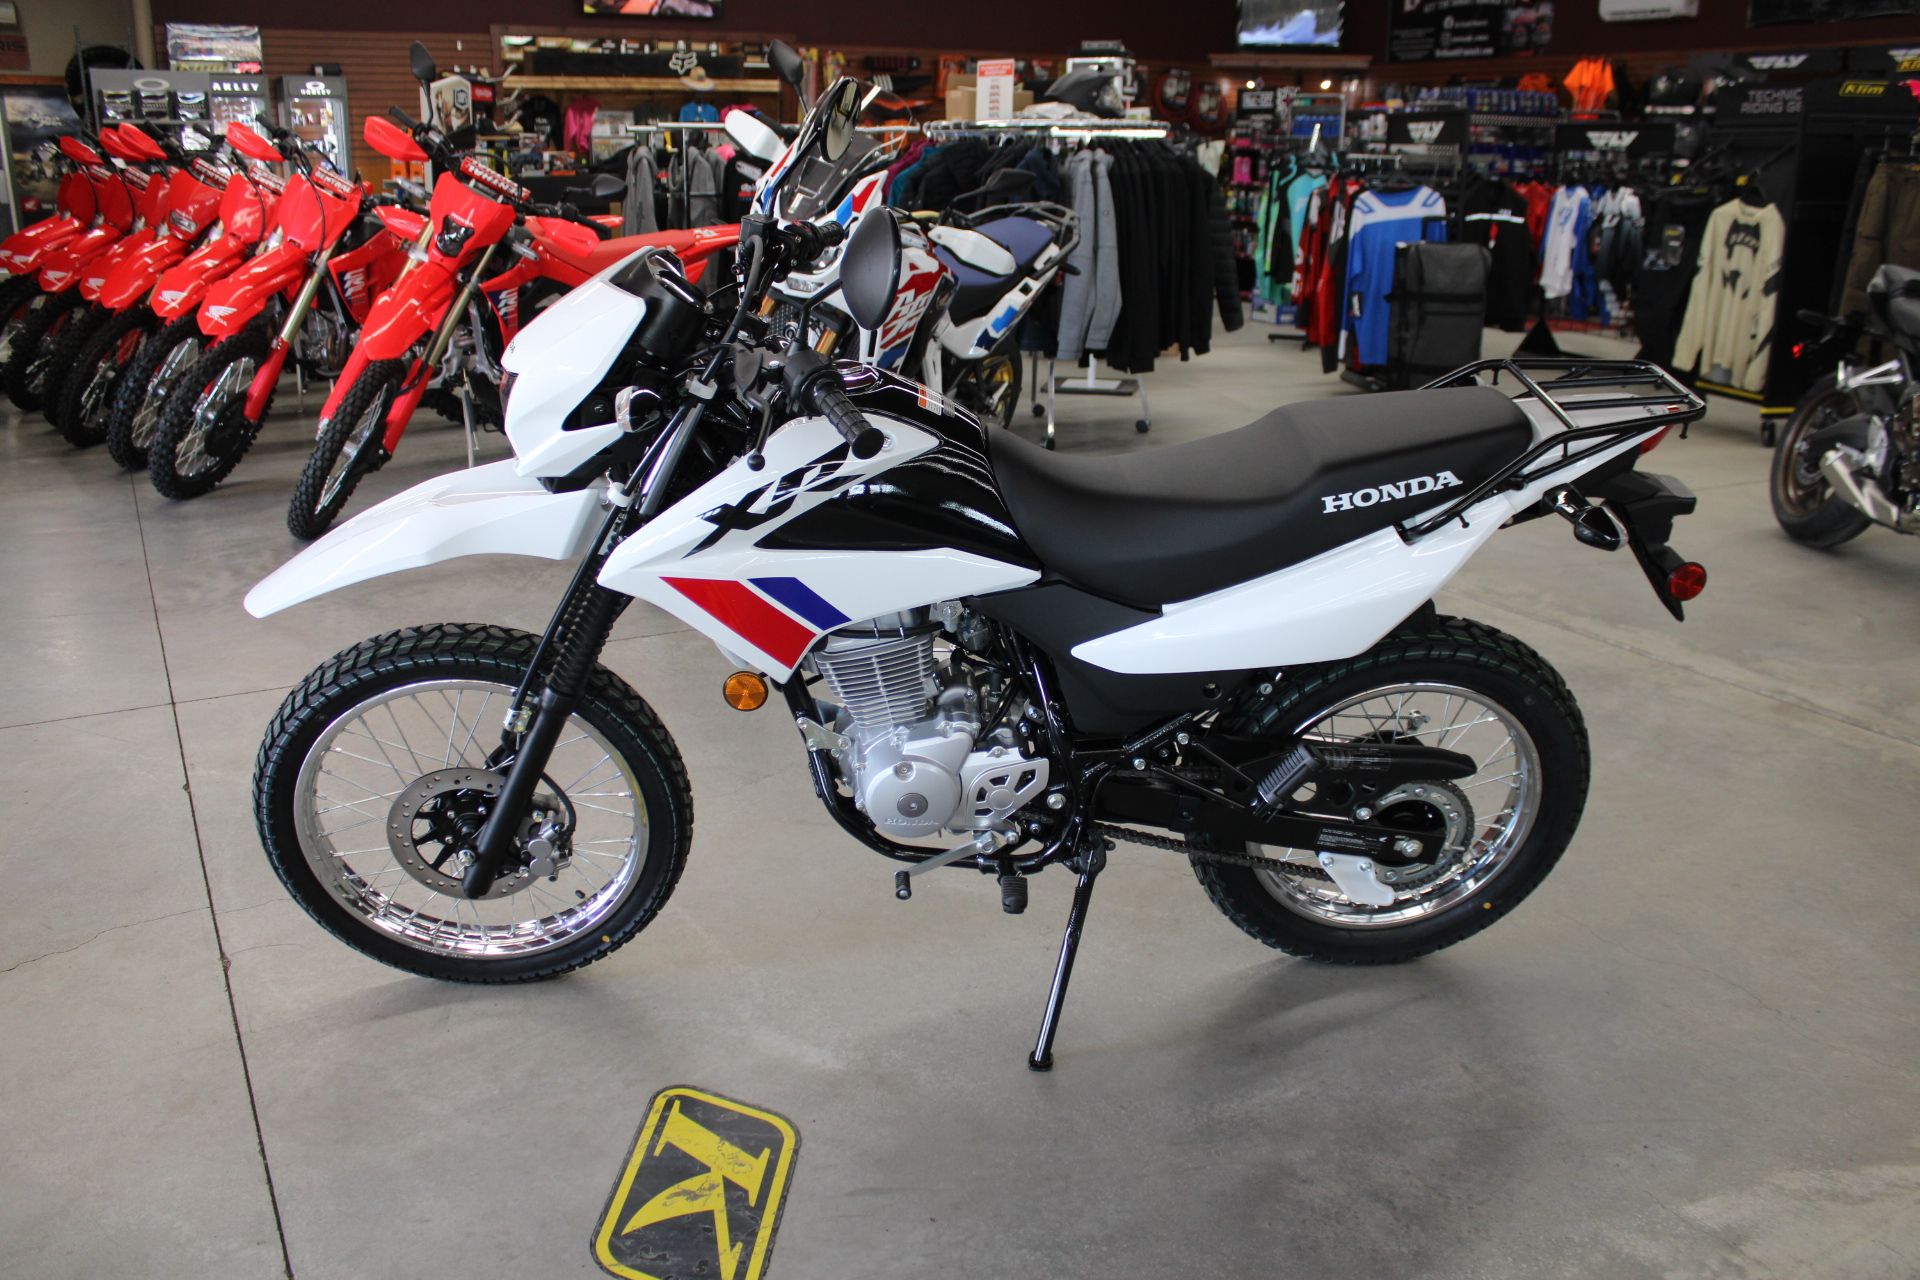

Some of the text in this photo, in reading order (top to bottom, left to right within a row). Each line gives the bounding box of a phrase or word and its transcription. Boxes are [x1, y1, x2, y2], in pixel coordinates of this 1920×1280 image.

[1748, 89, 1803, 101] TECHNIC
[1845, 84, 1887, 95] Klim
[1321, 470, 1464, 513] HONDA
